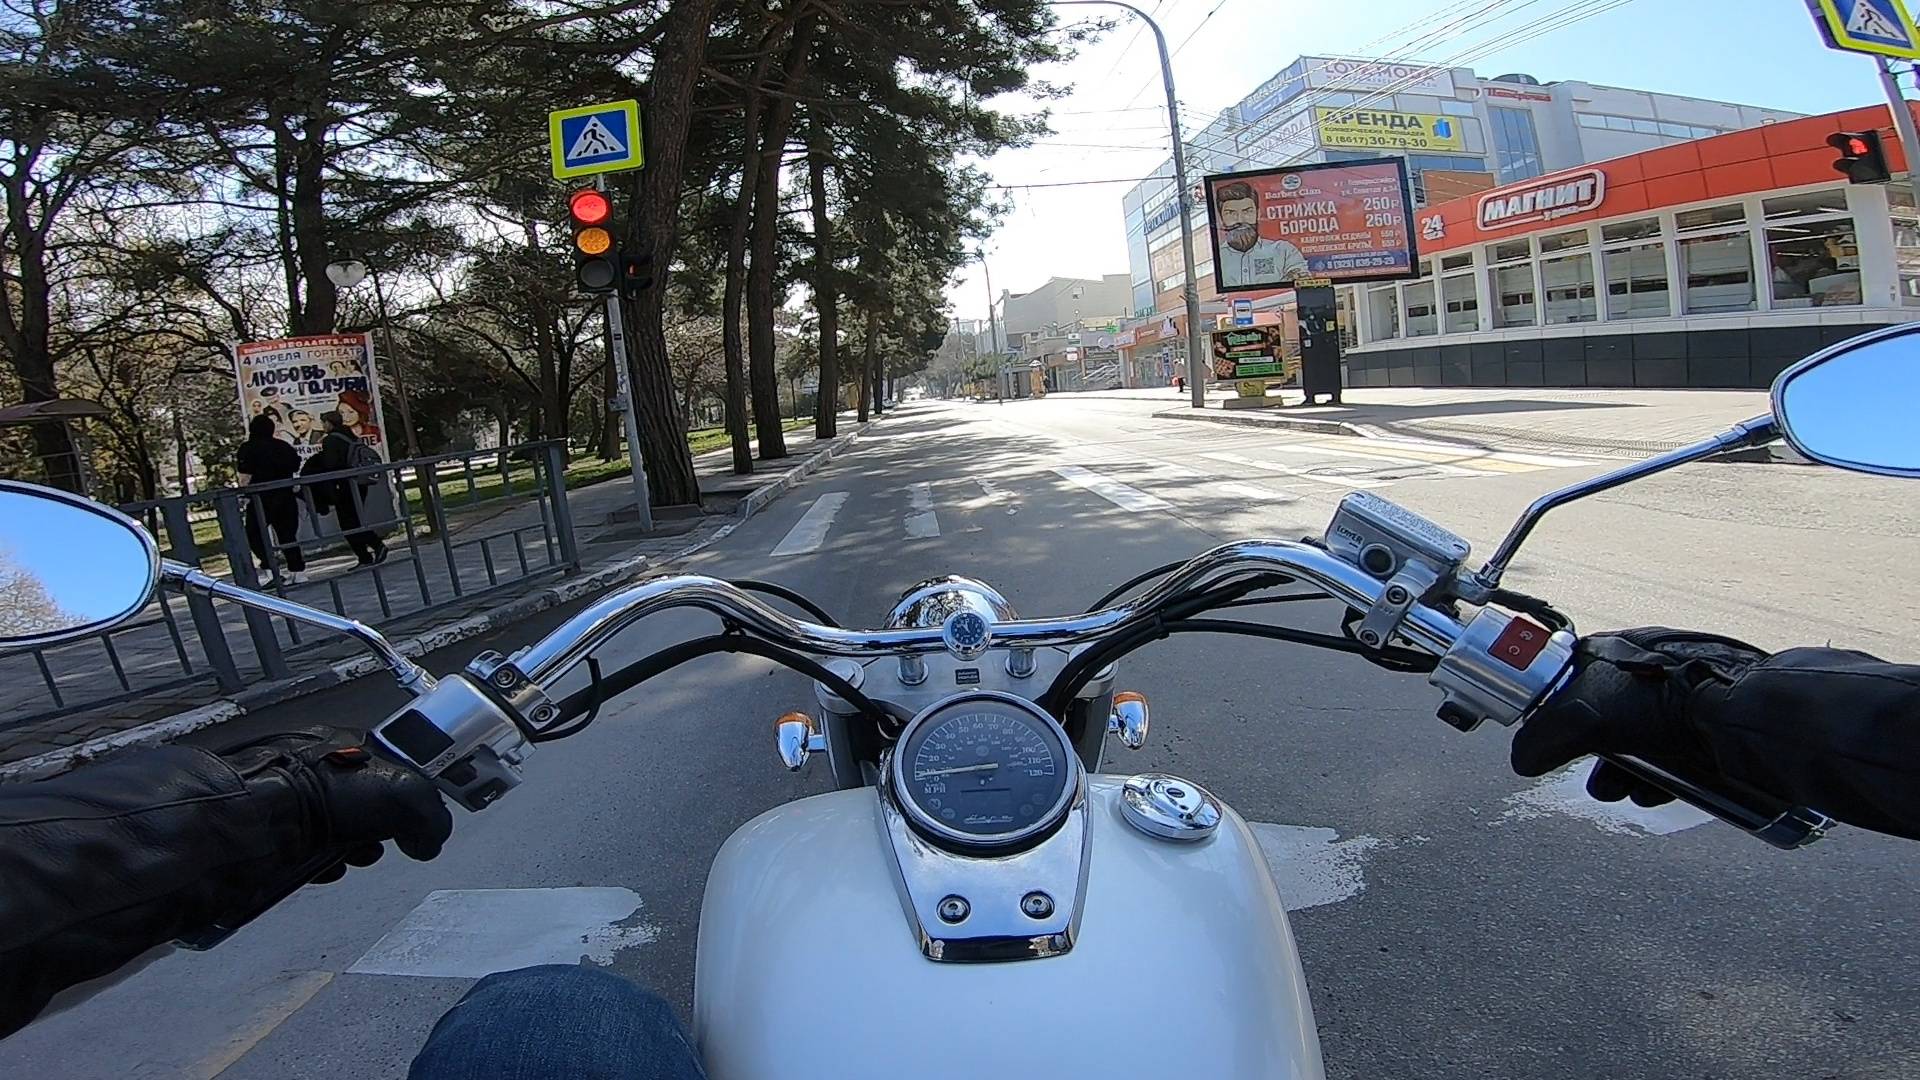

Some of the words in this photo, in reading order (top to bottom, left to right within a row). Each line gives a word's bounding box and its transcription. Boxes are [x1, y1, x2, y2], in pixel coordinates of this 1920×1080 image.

[1325, 111, 1423, 130] АРЕНДА
[1265, 190, 1297, 199] Barber
[1485, 178, 1595, 221] МАГНИТ
[1266, 200, 1337, 220] СТРИЖКА
[1280, 217, 1339, 235] БОРОДА
[1421, 215, 1443, 234] 24
[243, 356, 252, 366] 4
[255, 352, 301, 365] АПРЕЛЯ
[307, 347, 364, 359] ГОРТЕАТР
[247, 364, 326, 388] ЛЮБОВЬ
[297, 376, 368, 396] ГОЛУБИ
[958, 726, 969, 734] 50
